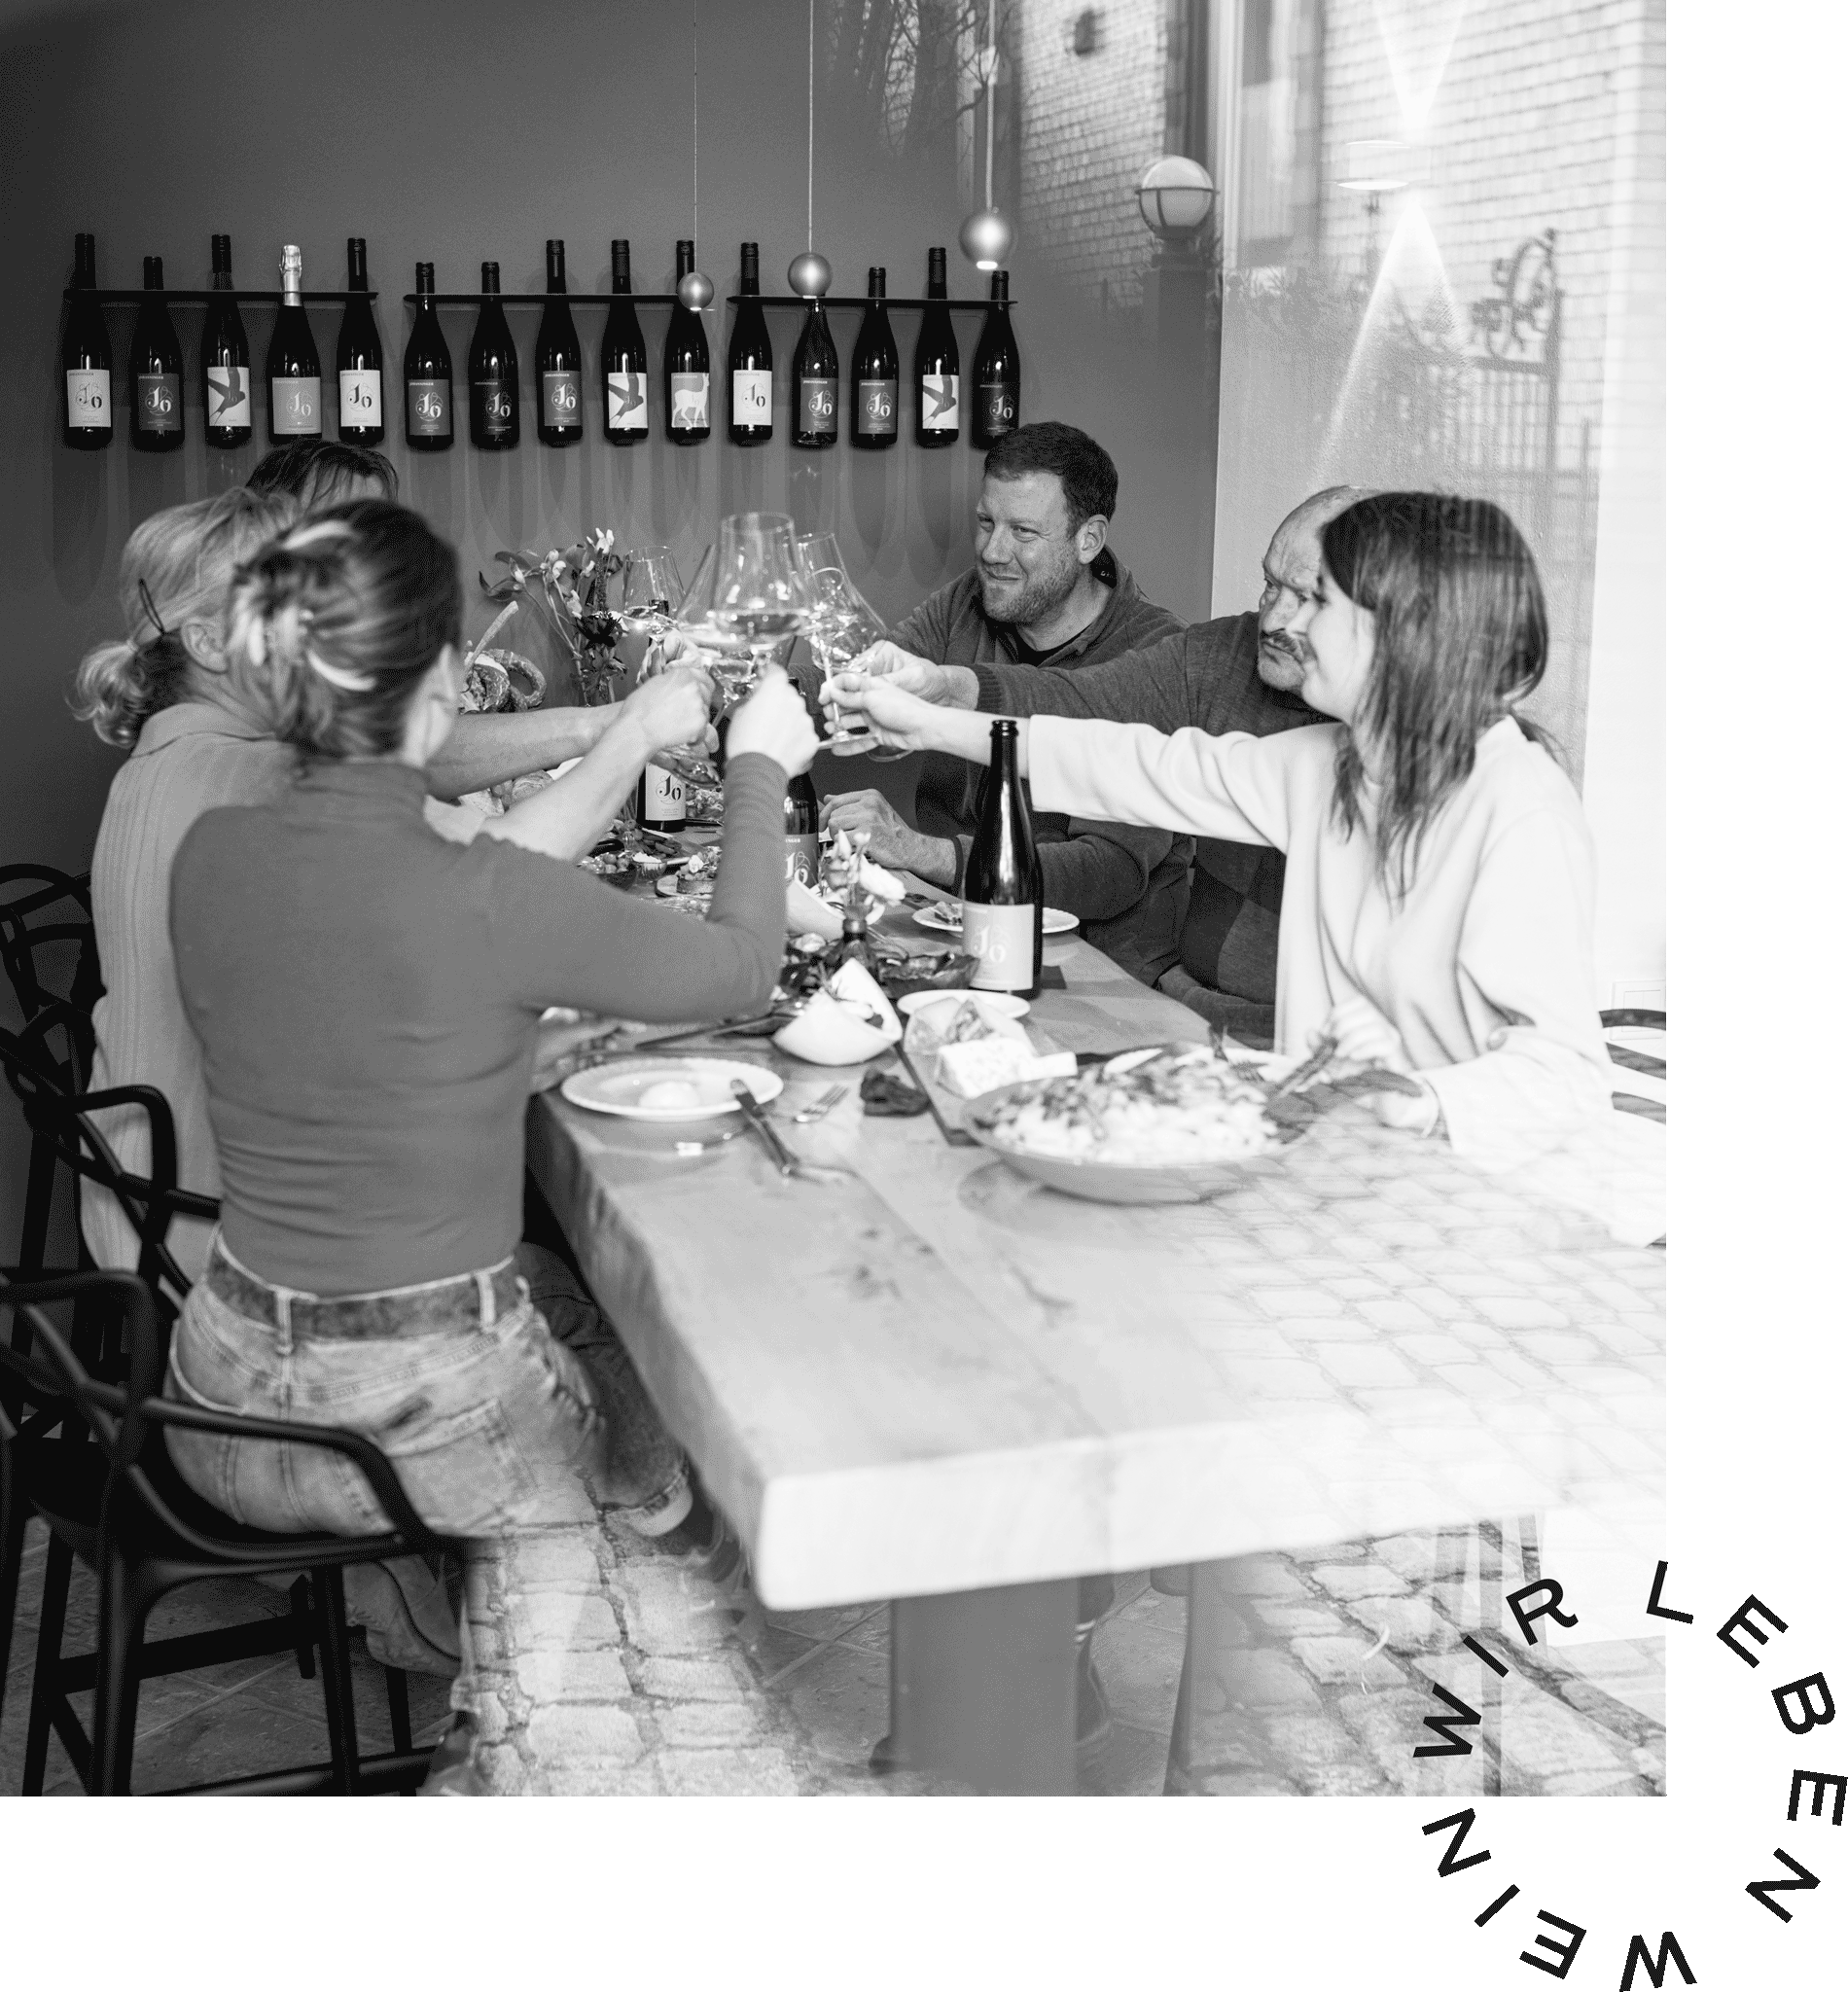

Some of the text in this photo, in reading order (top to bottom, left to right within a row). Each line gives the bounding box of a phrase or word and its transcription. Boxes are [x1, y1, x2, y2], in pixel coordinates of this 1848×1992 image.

[146, 386, 171, 412] Jo
[289, 391, 311, 416] Jo
[349, 383, 373, 409] Jo
[418, 392, 442, 417] Jo
[488, 392, 511, 417] Jo
[552, 383, 576, 409] Jo
[811, 390, 833, 415] Jo
[869, 392, 891, 416] Jo
[991, 395, 1013, 419] Jo
[658, 774, 682, 800] Jo
[974, 925, 1006, 963] Jo
